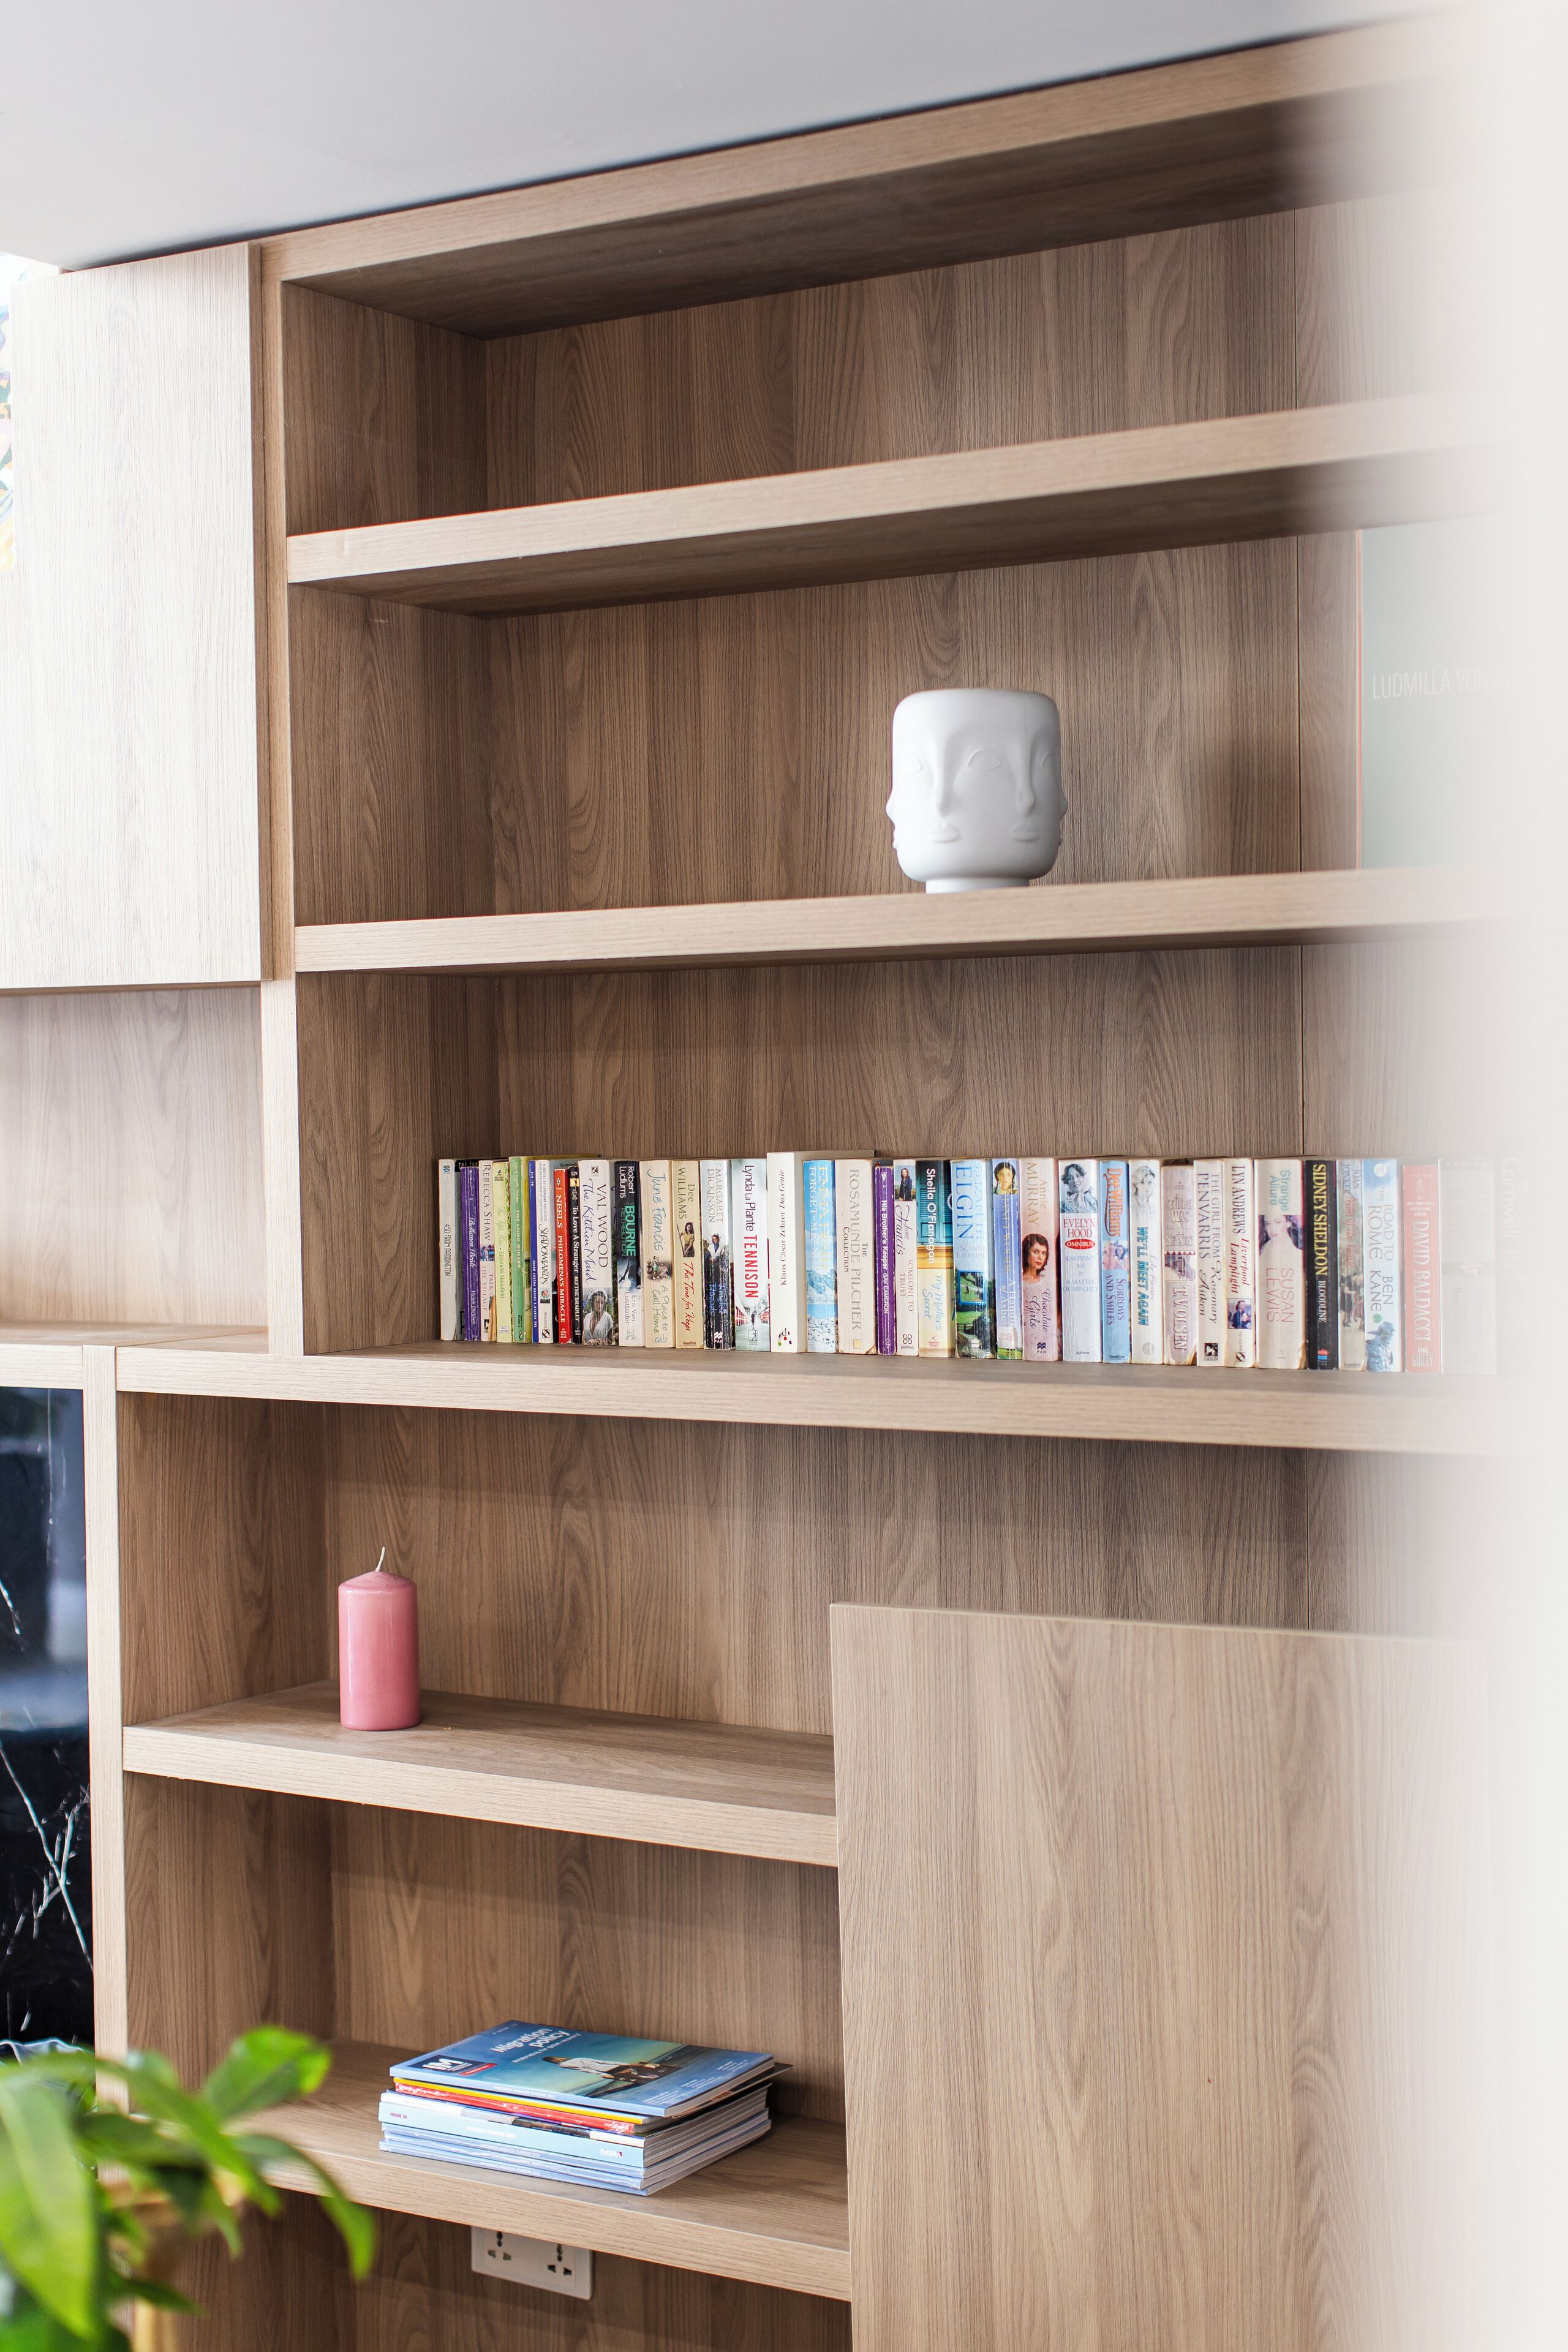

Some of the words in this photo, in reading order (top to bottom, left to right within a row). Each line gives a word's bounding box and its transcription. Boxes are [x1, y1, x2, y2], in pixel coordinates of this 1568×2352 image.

[1373, 669, 1450, 699] LUDMILLA
[483, 1164, 491, 1208] REBECCA
[582, 1178, 595, 1203] The
[627, 1166, 636, 1194] Robert
[647, 1168, 666, 1204] June
[677, 1167, 687, 1219] WILLIAMS
[742, 1165, 755, 1191] Lynda
[926, 1168, 936, 1200] Sheila
[1107, 1168, 1123, 1189] Dee
[1211, 1174, 1219, 1194] THE
[1232, 1166, 1246, 1185] LYN
[1269, 1175, 1280, 1206] Allure
[1278, 1169, 1291, 1212] Strange
[1313, 1164, 1327, 1213] SIDNEY
[1342, 1164, 1351, 1195] JONKER
[572, 1206, 579, 1215] To
[597, 1184, 607, 1210] VAL
[707, 1169, 715, 1223] DICKINSON
[715, 1169, 723, 1223] MARGARET
[956, 1166, 973, 1238] ELGIN
[1027, 1163, 1039, 1226] MURRAY
[1039, 1179, 1047, 1210] Annie
[1212, 1197, 1220, 1224] GIRL
[1232, 1187, 1246, 1234] ANDREWS
[483, 1212, 492, 1240] SHAW
[581, 1205, 595, 1246] Kitchen
[625, 1205, 636, 1256] BOURNE
[652, 1207, 666, 1251] Francis
[745, 1202, 756, 1232] Plante
[809, 1166, 819, 1271] FORGET-ME-NOT
[850, 1169, 861, 1262] ROSAMUNDE
[895, 1205, 906, 1256] Francis
[902, 1205, 913, 1240] June
[1063, 1218, 1095, 1228] EVELYN
[1107, 1189, 1124, 1237] Williams
[1197, 1173, 1210, 1259] PENVARRIS
[1383, 1204, 1394, 1240] ROAD
[597, 1215, 608, 1268] WOOD
[926, 1202, 937, 1264] O'Flanagan
[1068, 1228, 1091, 1238] HOOD
[1137, 1226, 1148, 1257] WE'LL
[1212, 1227, 1221, 1258] FROM
[1313, 1214, 1329, 1276] SHELDON
[1412, 1220, 1430, 1265] DAVID
[539, 1224, 549, 1284] SHADOWLANDS
[584, 1248, 597, 1285] Maid
[744, 1235, 758, 1298] TENNISON
[1229, 1243, 1240, 1294] Lamplight
[1240, 1238, 1250, 1286] Liverpool
[1384, 1242, 1395, 1261] TO
[684, 1261, 694, 1280] This
[1106, 1273, 1114, 1292] AND
[1137, 1260, 1148, 1290] MEET
[652, 1289, 661, 1306] Call
[661, 1284, 668, 1293] A
[682, 1297, 694, 1310] for
[684, 1281, 695, 1299] Time
[851, 1268, 862, 1330] PILCHER
[922, 1289, 933, 1321] Secret
[1117, 1278, 1126, 1321] SORROWS
[1199, 1269, 1210, 1316] Aitken
[1209, 1260, 1221, 1324] Rosemary
[1265, 1267, 1281, 1323] LEWIS
[1281, 1267, 1294, 1322] SUSAN
[1317, 1280, 1327, 1323] BLOODLINE
[1370, 1270, 1382, 1312] KANE
[1382, 1276, 1393, 1305] BEN
[1414, 1269, 1431, 1341] BALDACCI
[653, 1308, 662, 1333] Home
[681, 1312, 695, 1332] Keeps
[908, 1301, 914, 1312] TO
[934, 1293, 944, 1331] Mother's
[1001, 1296, 1010, 1325] Ashes
[1025, 1295, 1041, 1329] Girls
[1041, 1288, 1052, 1333] Chocolate
[1106, 1294, 1116, 1325] SMILES
[1137, 1291, 1149, 1326] AGAIN
[662, 1322, 668, 1331] to
[1412, 1353, 1433, 1367] GUILTY
[490, 2029, 553, 2053] Migration
